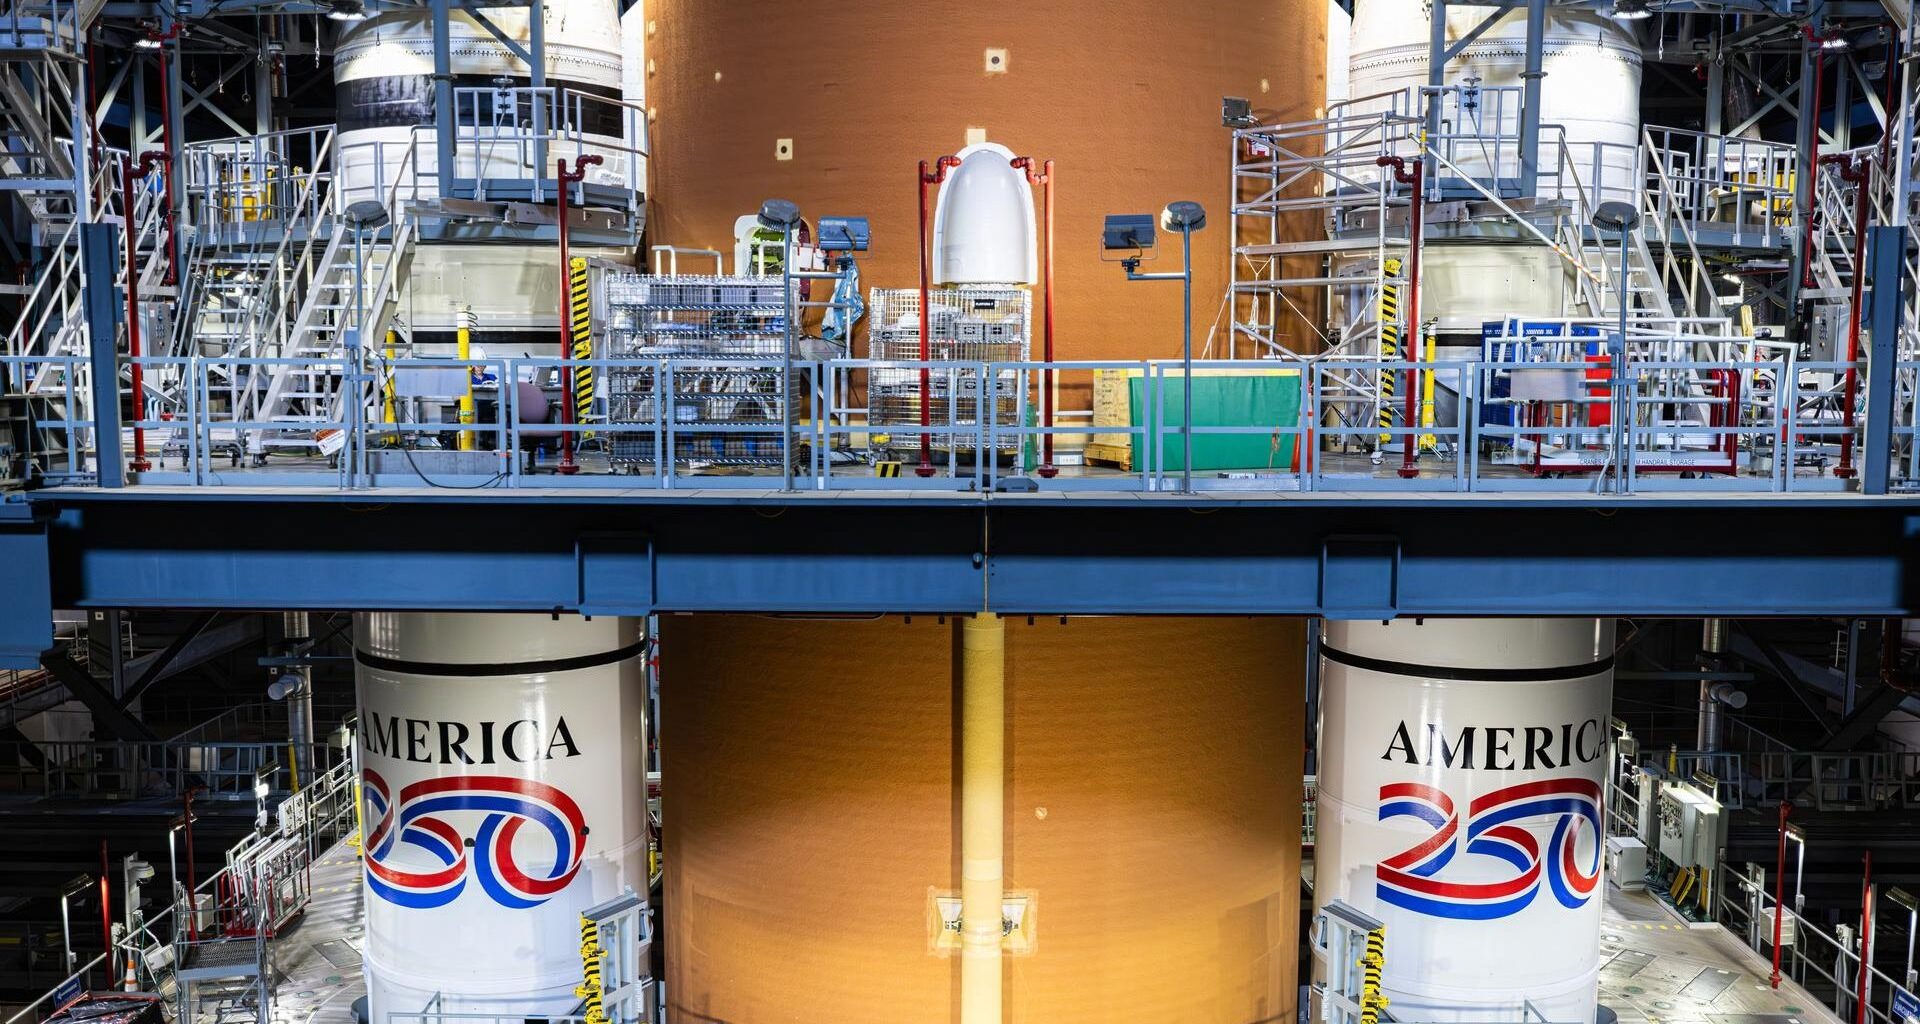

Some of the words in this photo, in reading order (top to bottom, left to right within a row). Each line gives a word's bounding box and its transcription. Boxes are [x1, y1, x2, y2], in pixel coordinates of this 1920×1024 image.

[361, 706, 581, 765] AMERICA
[1381, 715, 1607, 770] AMERICA
[363, 768, 587, 909] 250
[1376, 777, 1604, 920] 250
